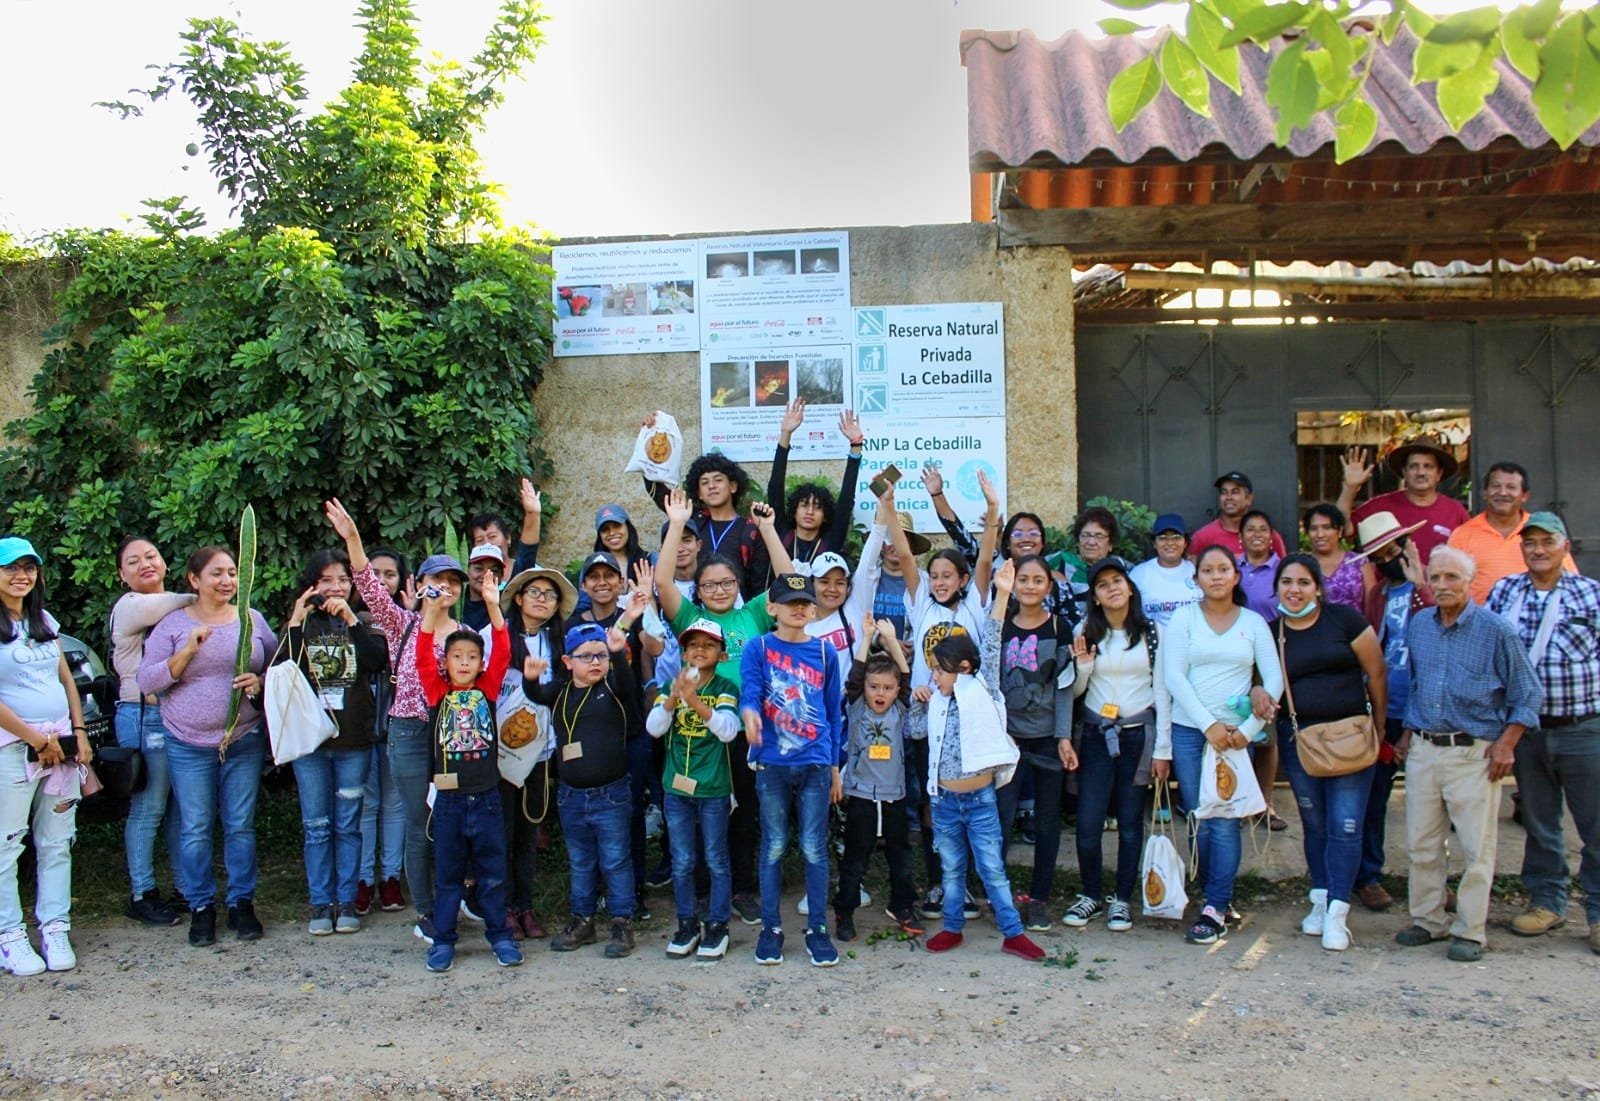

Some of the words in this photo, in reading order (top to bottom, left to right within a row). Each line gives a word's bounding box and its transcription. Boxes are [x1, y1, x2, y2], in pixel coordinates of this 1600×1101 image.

[888, 323, 942, 338] Reserva
[947, 320, 998, 336] Natural
[921, 346, 972, 362] Privada
[901, 372, 917, 385] La
[922, 370, 992, 385] Cebadilla
[894, 438, 909, 450] La
[914, 436, 982, 450] Cebadilla
[860, 498, 929, 510] ornica
